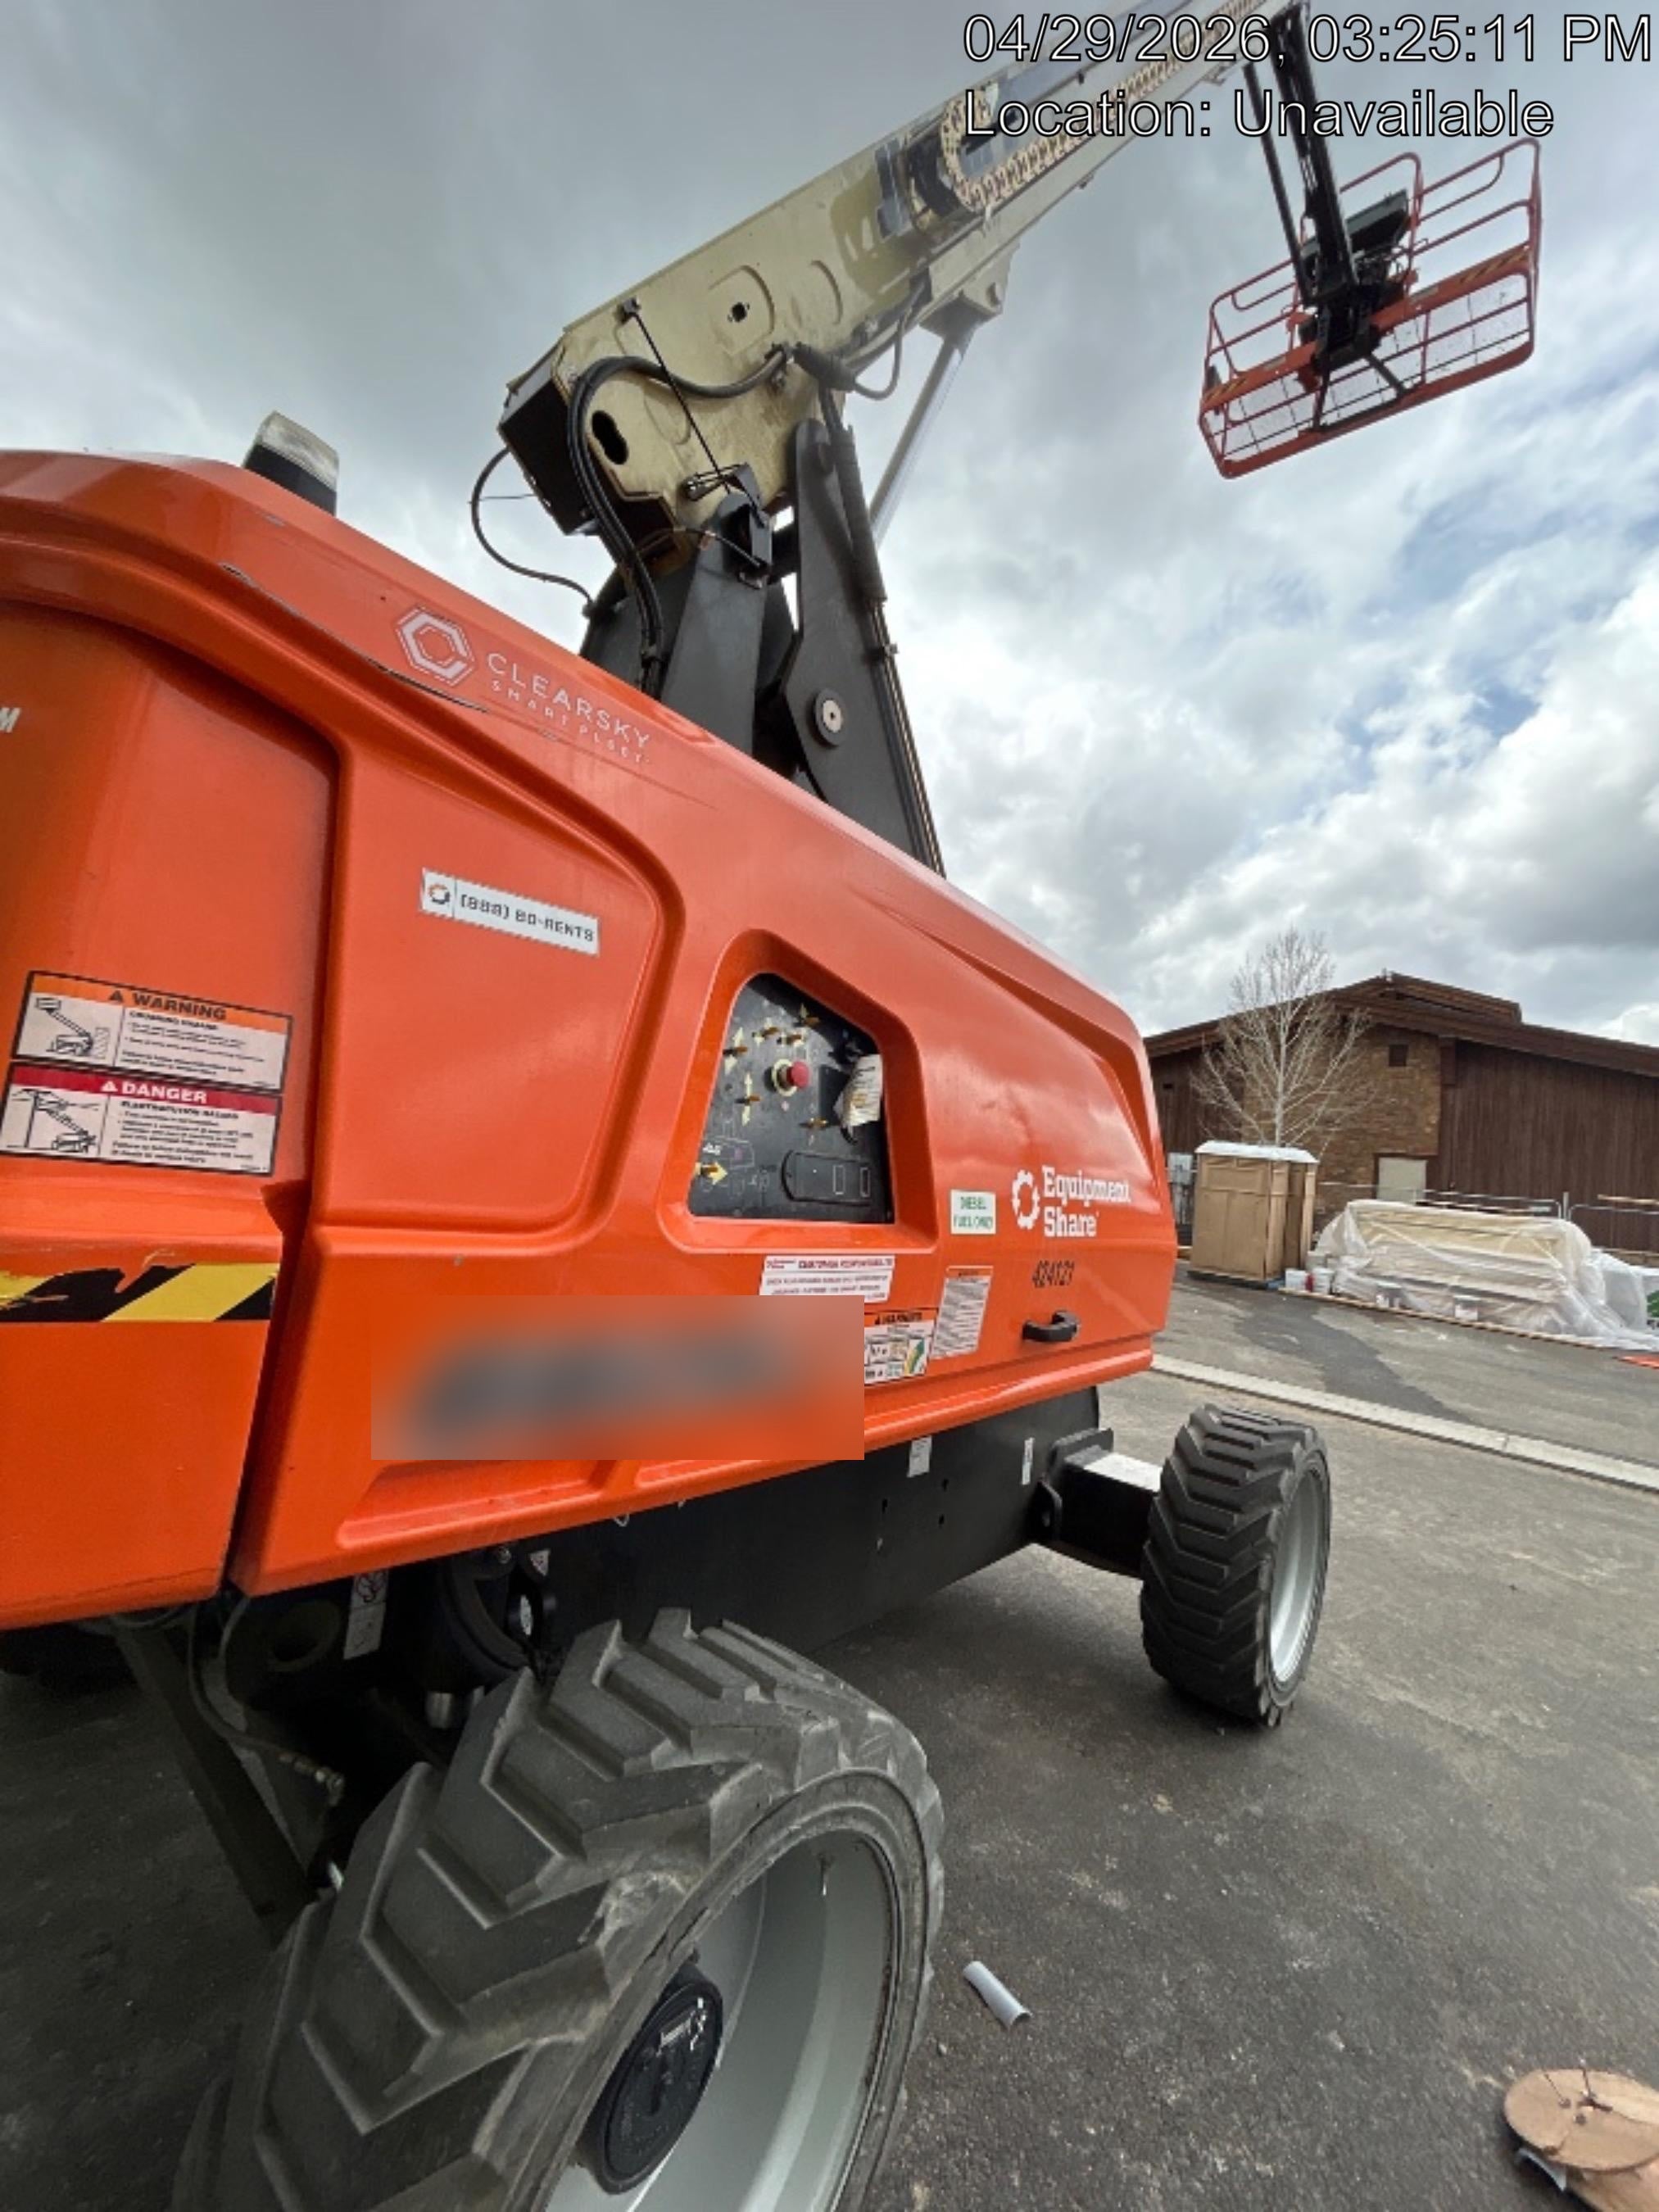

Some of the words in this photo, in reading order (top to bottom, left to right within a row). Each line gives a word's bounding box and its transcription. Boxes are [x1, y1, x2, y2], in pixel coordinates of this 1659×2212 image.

[487, 653, 650, 748] CLEARSKY
[133, 992, 228, 1021] WARNING
[121, 1081, 208, 1104] DANGER
[1041, 1164, 1132, 1208] Equipment
[1044, 1207, 1097, 1237] Share
